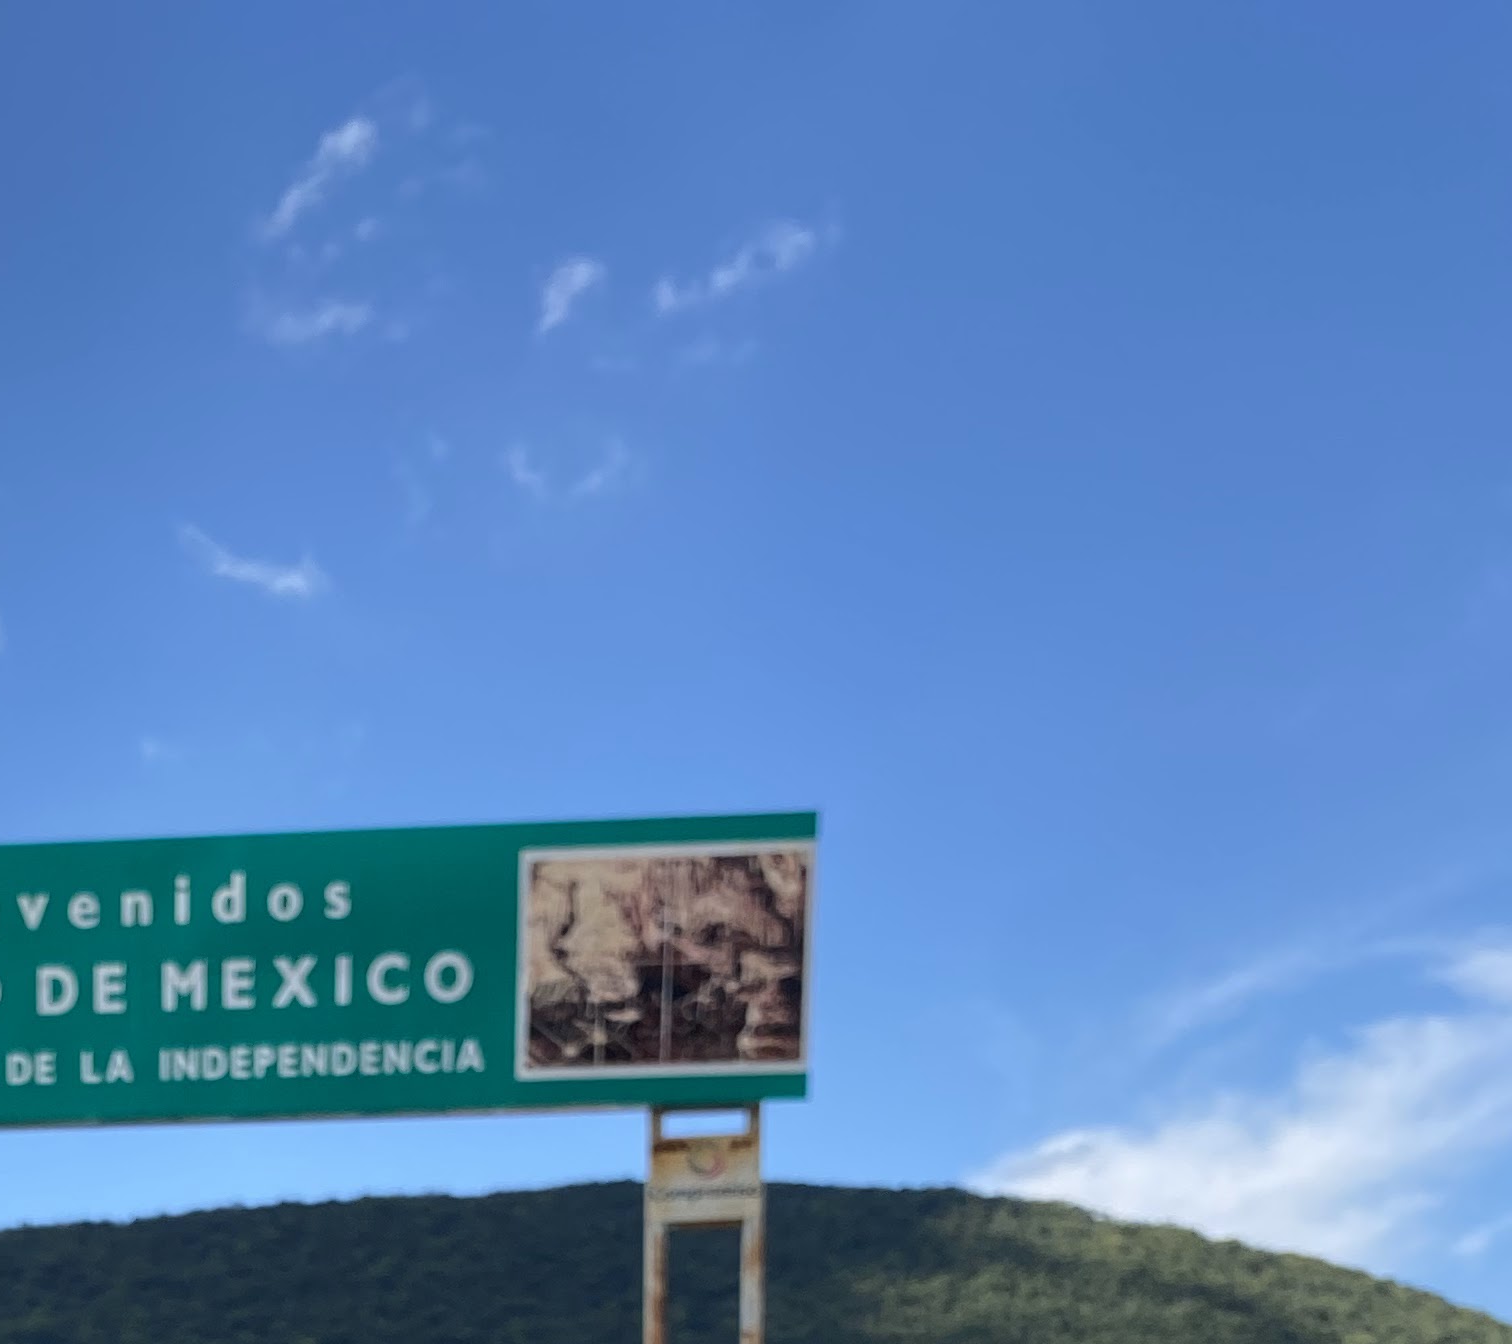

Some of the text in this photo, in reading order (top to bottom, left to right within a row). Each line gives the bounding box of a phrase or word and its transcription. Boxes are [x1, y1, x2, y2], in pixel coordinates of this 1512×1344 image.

[35, 960, 128, 1016] DE
[160, 948, 475, 1012] MEXICO
[5, 1050, 57, 1087] DE
[80, 1047, 135, 1084] LA
[159, 1036, 485, 1082] INDEPENDENCIA
